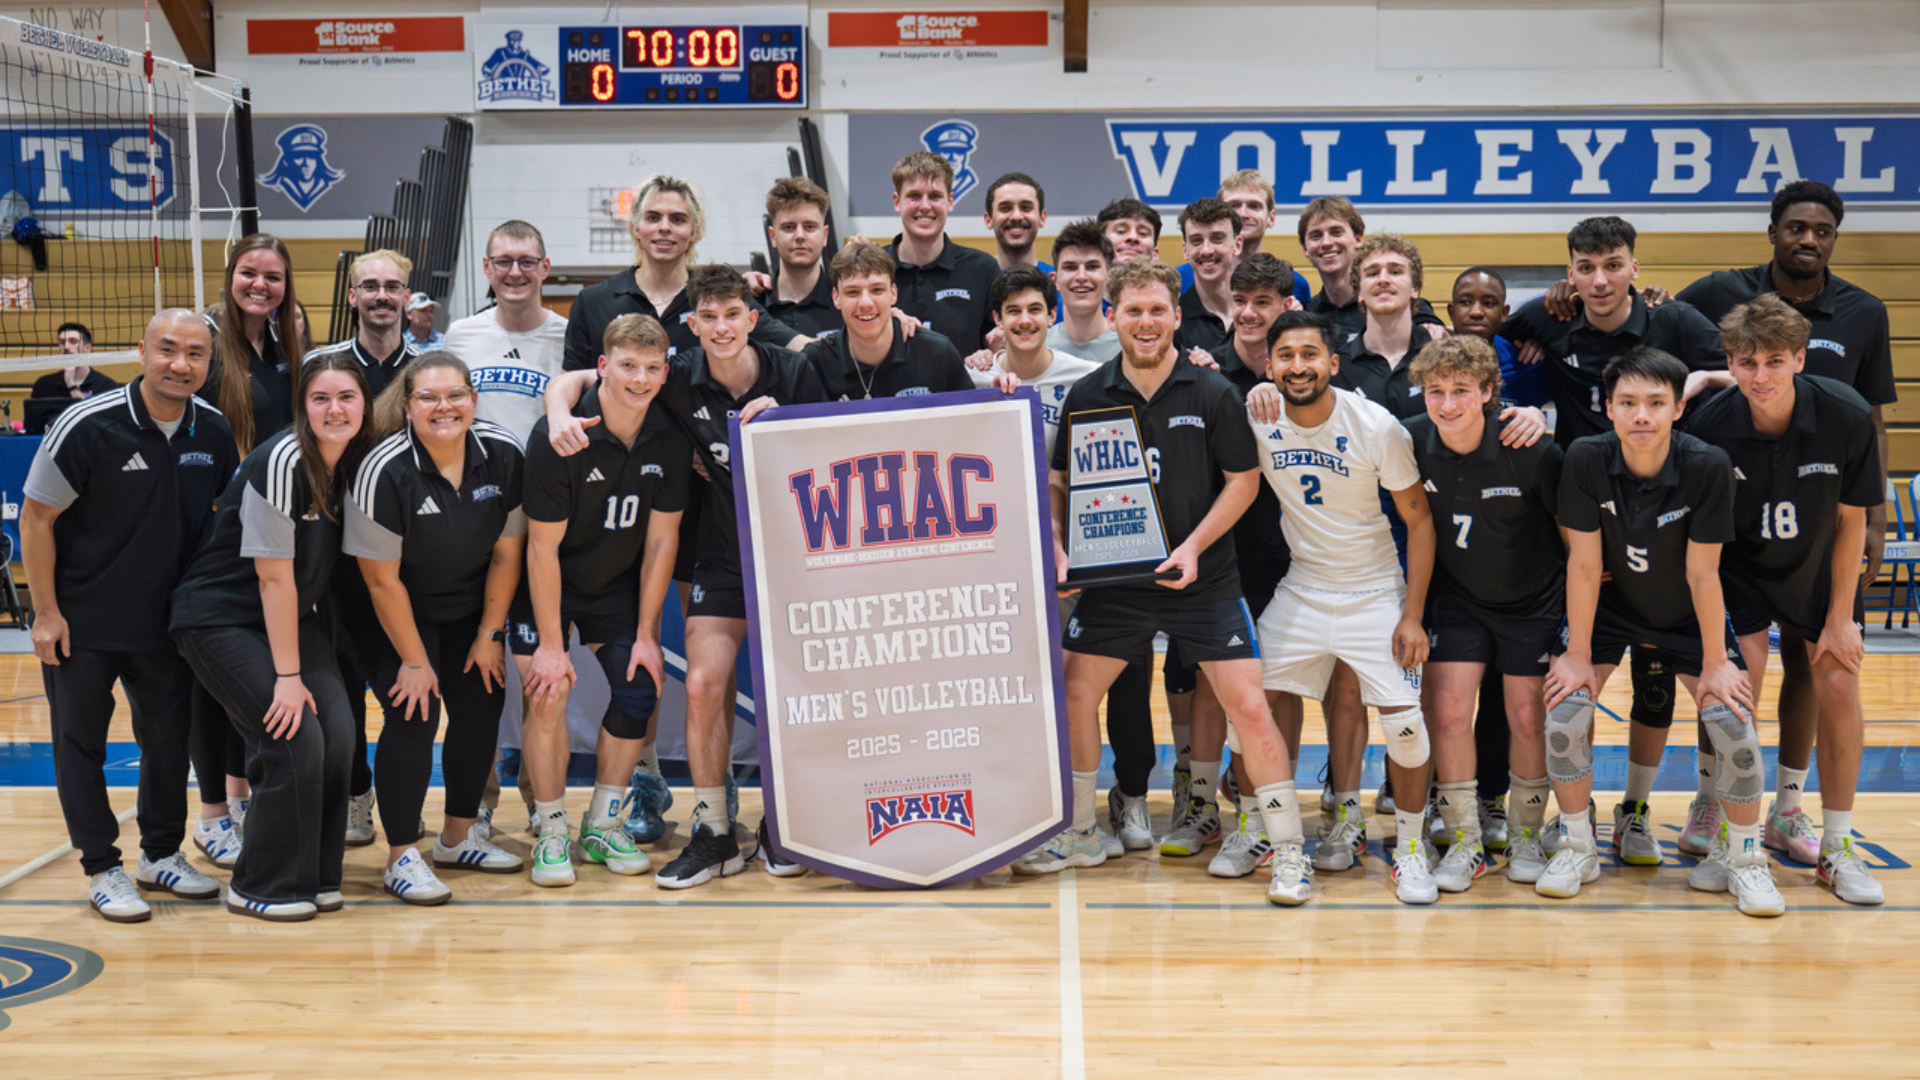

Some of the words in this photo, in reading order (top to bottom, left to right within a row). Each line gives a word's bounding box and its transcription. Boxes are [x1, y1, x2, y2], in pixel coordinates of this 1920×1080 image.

[69, 7, 106, 31] WAY
[335, 22, 396, 34] Source
[918, 15, 979, 28] Source
[918, 27, 963, 39] Bank
[21, 23, 65, 52] BETHEL
[335, 33, 380, 46] Bank
[626, 29, 738, 67] 70:00
[567, 48, 612, 63] HOME
[750, 47, 798, 62] GUEST
[478, 76, 556, 102] BETHEL
[591, 64, 614, 101] 0
[661, 73, 704, 86] PERIOD
[776, 62, 799, 100] 0
[1120, 127, 1920, 197] VOLLEYBAL
[471, 367, 549, 395] BETHEL
[1073, 439, 1139, 473] WHAC
[1271, 448, 1350, 478] BETHEL
[788, 450, 998, 553] WHAC
[1299, 473, 1324, 506] 2
[603, 494, 640, 531] 10
[1078, 507, 1148, 526] CONFERENCE
[1760, 501, 1800, 540] 18
[1083, 521, 1146, 539] CHAMPIONS
[1452, 513, 1473, 550] 7
[896, 543, 938, 558] ATHLETIC
[940, 538, 995, 554] CONFERENCE
[1626, 544, 1650, 574] 5
[787, 581, 1021, 636] CONFERENCE
[801, 620, 1013, 673] CHAMPIONS
[785, 689, 869, 726] MEN'S
[873, 675, 1036, 716] VOLLEYBALL
[847, 733, 902, 759] 2025
[925, 726, 981, 750] 2026
[868, 792, 973, 839] NAIA
